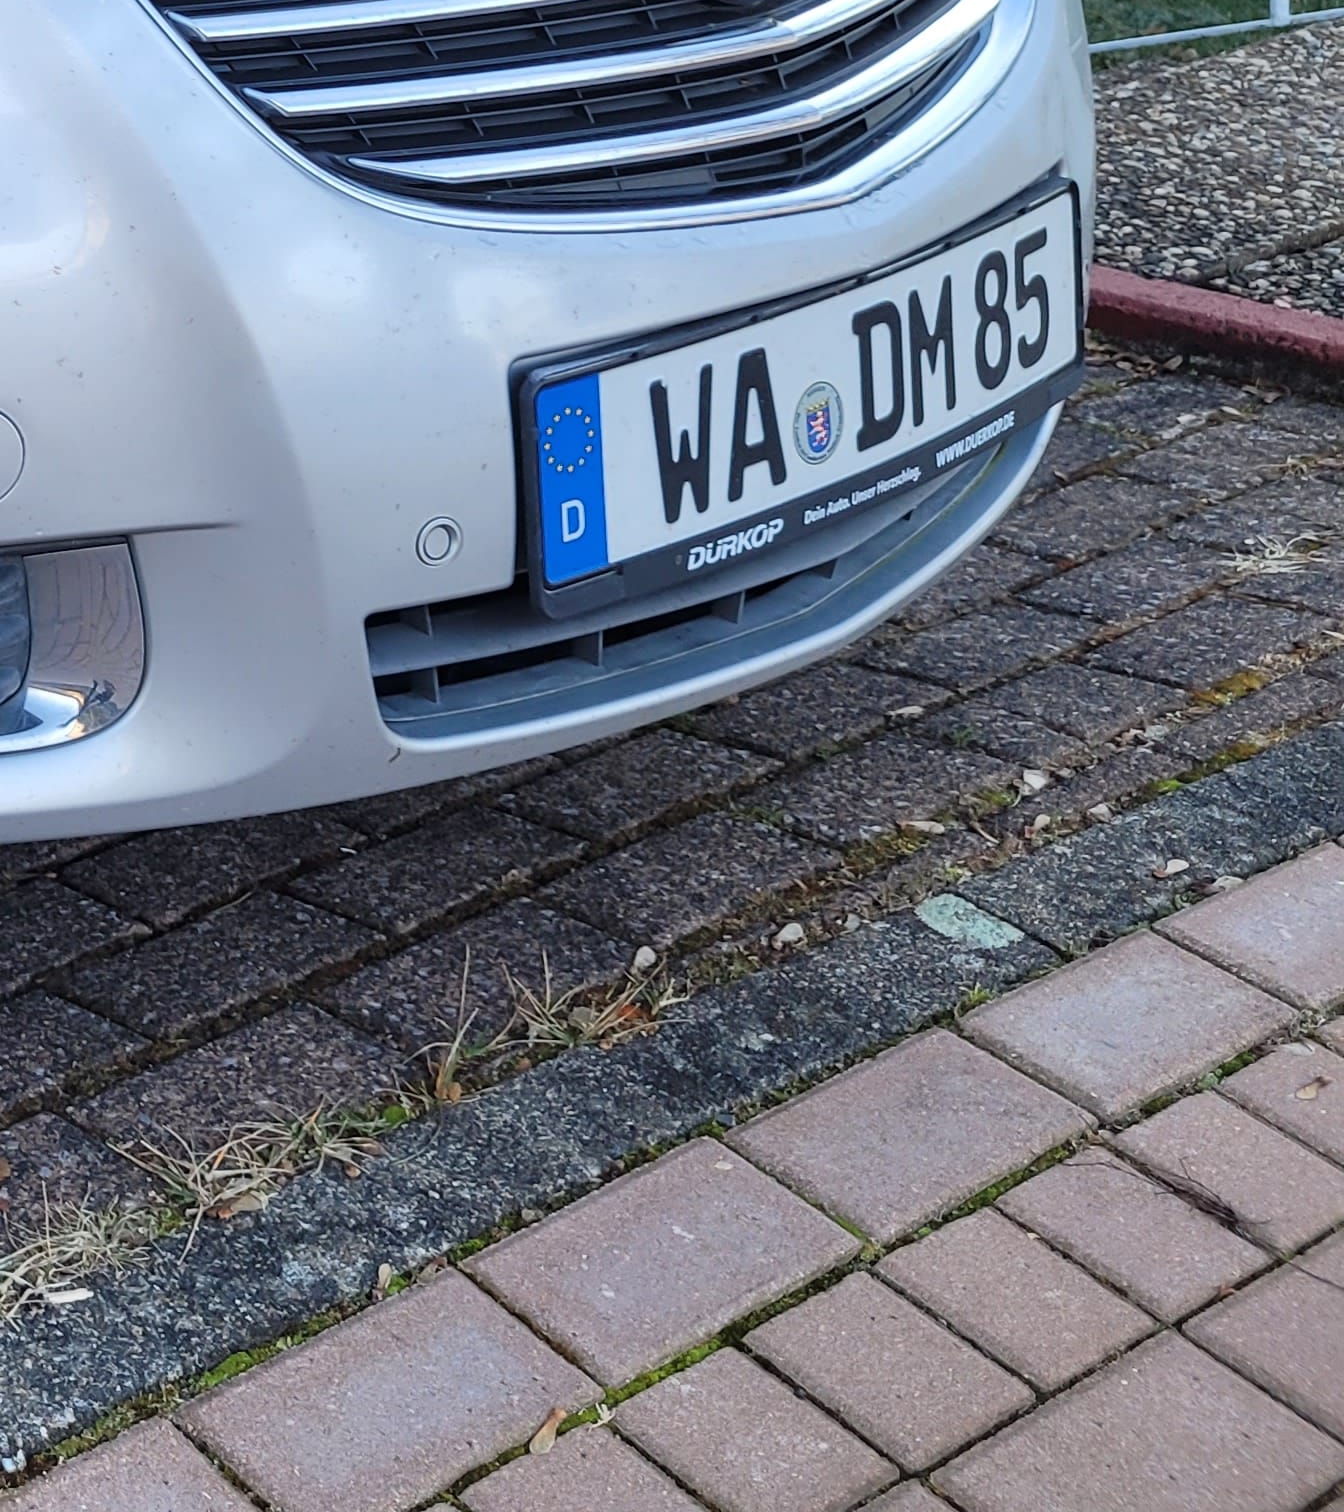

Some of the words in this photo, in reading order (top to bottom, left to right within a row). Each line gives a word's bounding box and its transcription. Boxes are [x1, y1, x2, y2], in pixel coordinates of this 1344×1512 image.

[649, 347, 787, 524] WA
[852, 275, 957, 452] DM
[974, 226, 1050, 391] 85
[561, 498, 586, 544] D
[803, 505, 826, 525] Dein
